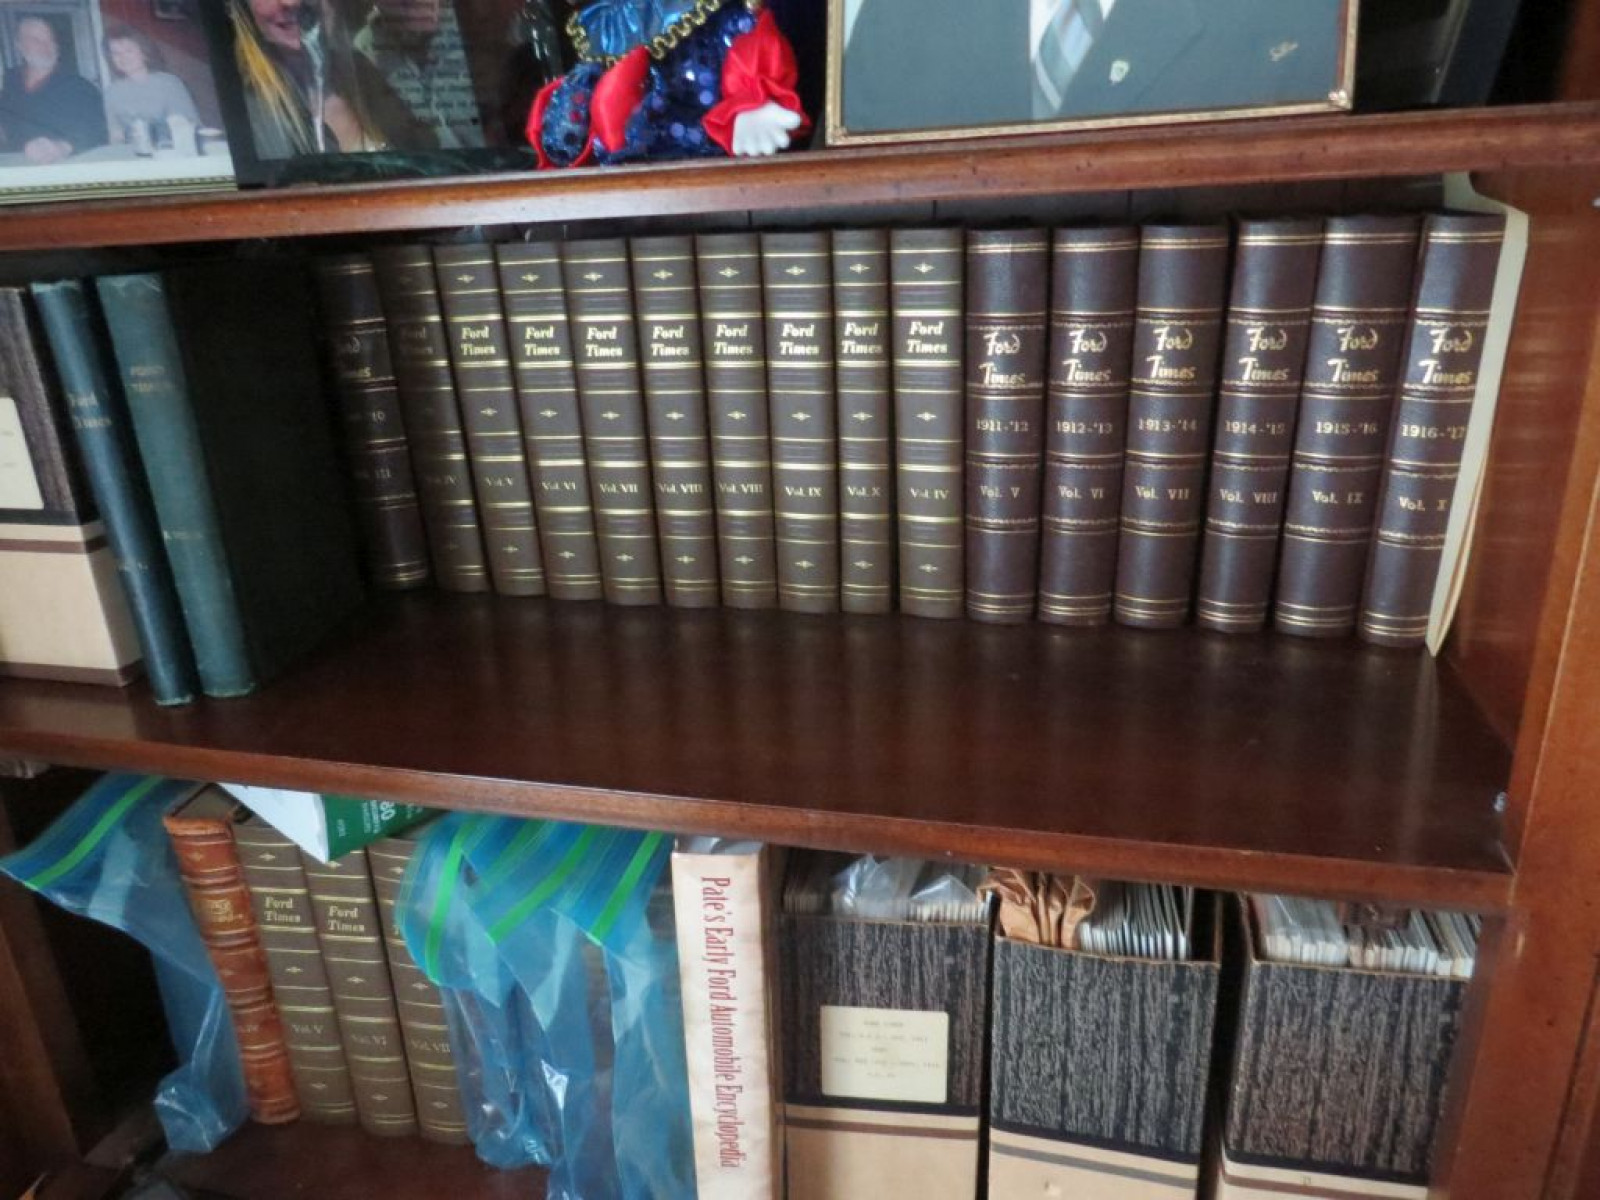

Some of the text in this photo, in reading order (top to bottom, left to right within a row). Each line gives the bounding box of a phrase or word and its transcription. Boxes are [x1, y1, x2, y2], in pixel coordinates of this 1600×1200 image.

[461, 326, 490, 340] Ford
[525, 326, 554, 340] Ford
[586, 326, 618, 341] Ford
[652, 326, 684, 340] Ford
[716, 324, 749, 338] Ford
[782, 323, 815, 338] Ford
[844, 322, 879, 337] Ford
[909, 321, 944, 336] Ford
[983, 330, 1021, 356] Ford
[1069, 329, 1107, 354] Ford
[1153, 327, 1193, 351] Ford
[1247, 326, 1287, 352] Ford
[1337, 326, 1379, 352] Ford
[1431, 329, 1473, 354] Ford
[460, 343, 496, 356] Times
[525, 343, 561, 356] Times
[585, 344, 623, 357] Times
[651, 343, 690, 356] Times
[714, 341, 753, 356] Times
[779, 341, 820, 355] Times
[841, 340, 883, 355] Times
[906, 339, 948, 354] Times
[979, 362, 1025, 384] Times
[1063, 359, 1111, 382] Times
[1146, 355, 1196, 379] Times
[1238, 357, 1290, 381] Times
[1327, 358, 1379, 382] Times
[1418, 359, 1473, 384] Times
[619, 483, 639, 493] VII
[808, 486, 823, 497] IX
[871, 486, 881, 497] X
[933, 488, 950, 499] IV
[1010, 486, 1021, 498] V
[1091, 487, 1104, 499] VI
[1168, 488, 1189, 500] VII
[1253, 491, 1277, 503] VIII
[1347, 491, 1363, 504] IX
[264, 897, 293, 910] Ford
[263, 910, 301, 923] Times
[328, 905, 359, 919] Ford
[327, 919, 365, 933] Times
[701, 877, 747, 1168] Pate's Early Ford Automobile Encyclopedia
